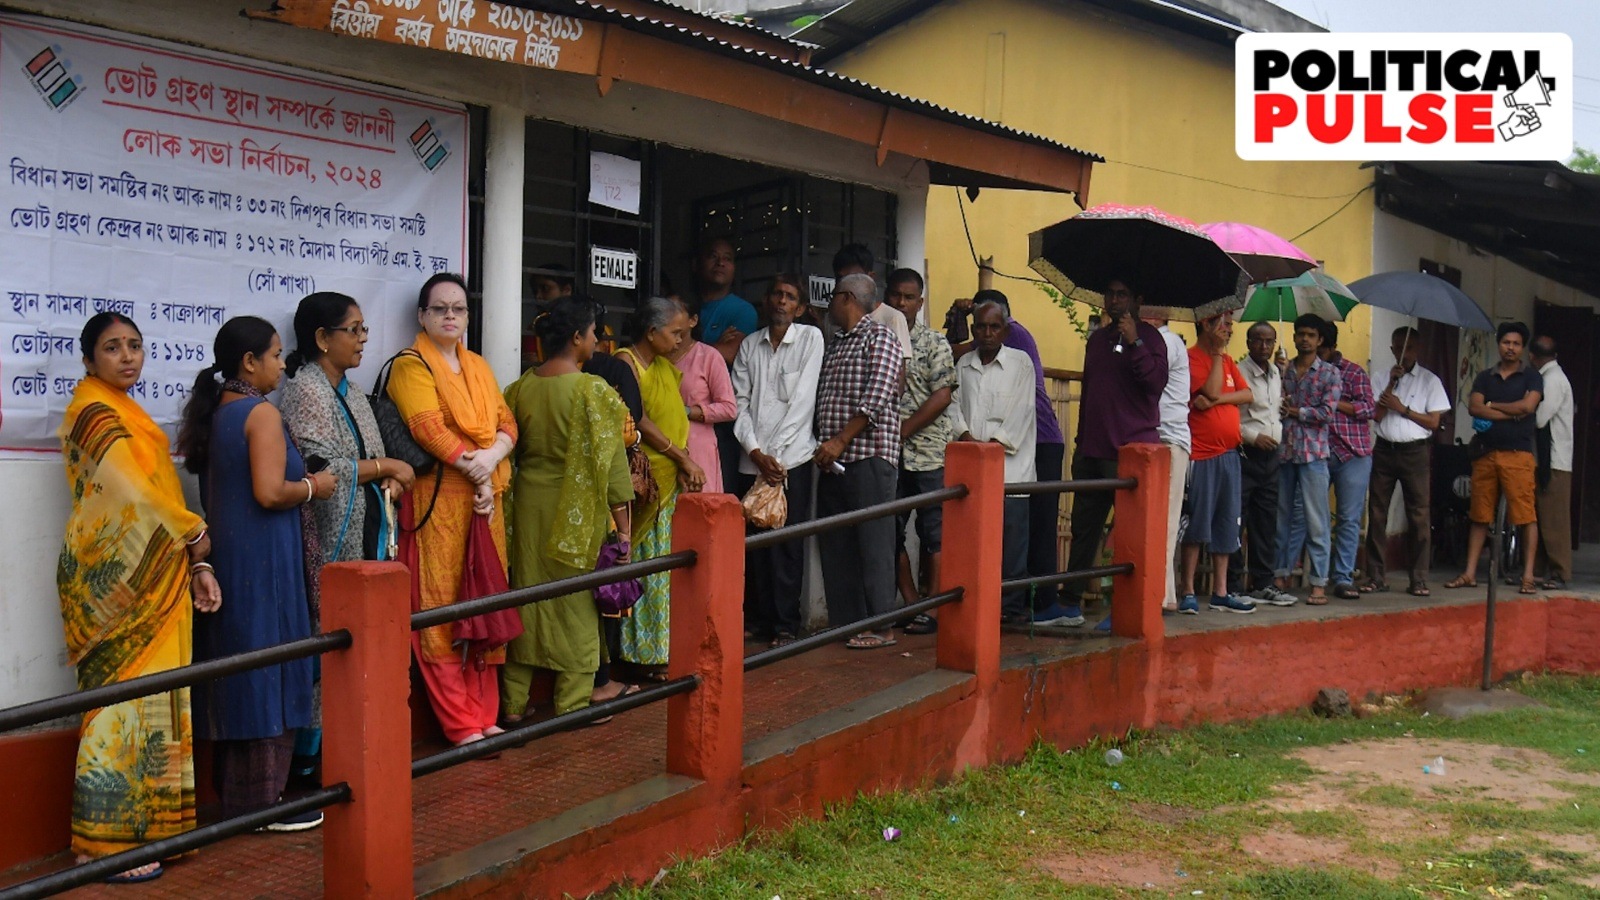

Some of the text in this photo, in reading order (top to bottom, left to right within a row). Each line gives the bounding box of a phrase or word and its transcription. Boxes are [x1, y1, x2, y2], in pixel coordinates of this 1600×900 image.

[488, 2, 583, 41] ২০১০-২০১১
[105, 62, 157, 98] ভোট
[221, 87, 259, 124] স্থান
[341, 107, 396, 143] জাননী
[123, 128, 182, 157] লোক
[189, 138, 232, 167] সভা
[324, 161, 382, 190] ২০২৪
[10, 157, 57, 188] বিধান
[62, 170, 93, 193] সভা
[152, 183, 168, 203] নং
[173, 186, 204, 207] আৰু
[208, 190, 232, 211] নাম
[247, 198, 267, 213] ৩৩
[271, 200, 286, 218] নং
[335, 202, 368, 229] বিধান
[371, 212, 396, 232] সভা
[11, 203, 50, 229] ভোট
[146, 222, 163, 244] নং
[167, 224, 199, 245] আৰু
[203, 228, 227, 249] নাম
[248, 234, 276, 255] ১৭২
[279, 238, 295, 257] নং
[594, 255, 634, 282] FEMALE
[8, 291, 40, 318] স্থান
[811, 280, 832, 302] MA
[164, 342, 204, 362] ১১৮৪
[12, 370, 48, 397] ভোট
[53, 375, 81, 396] গ্ৰহ
